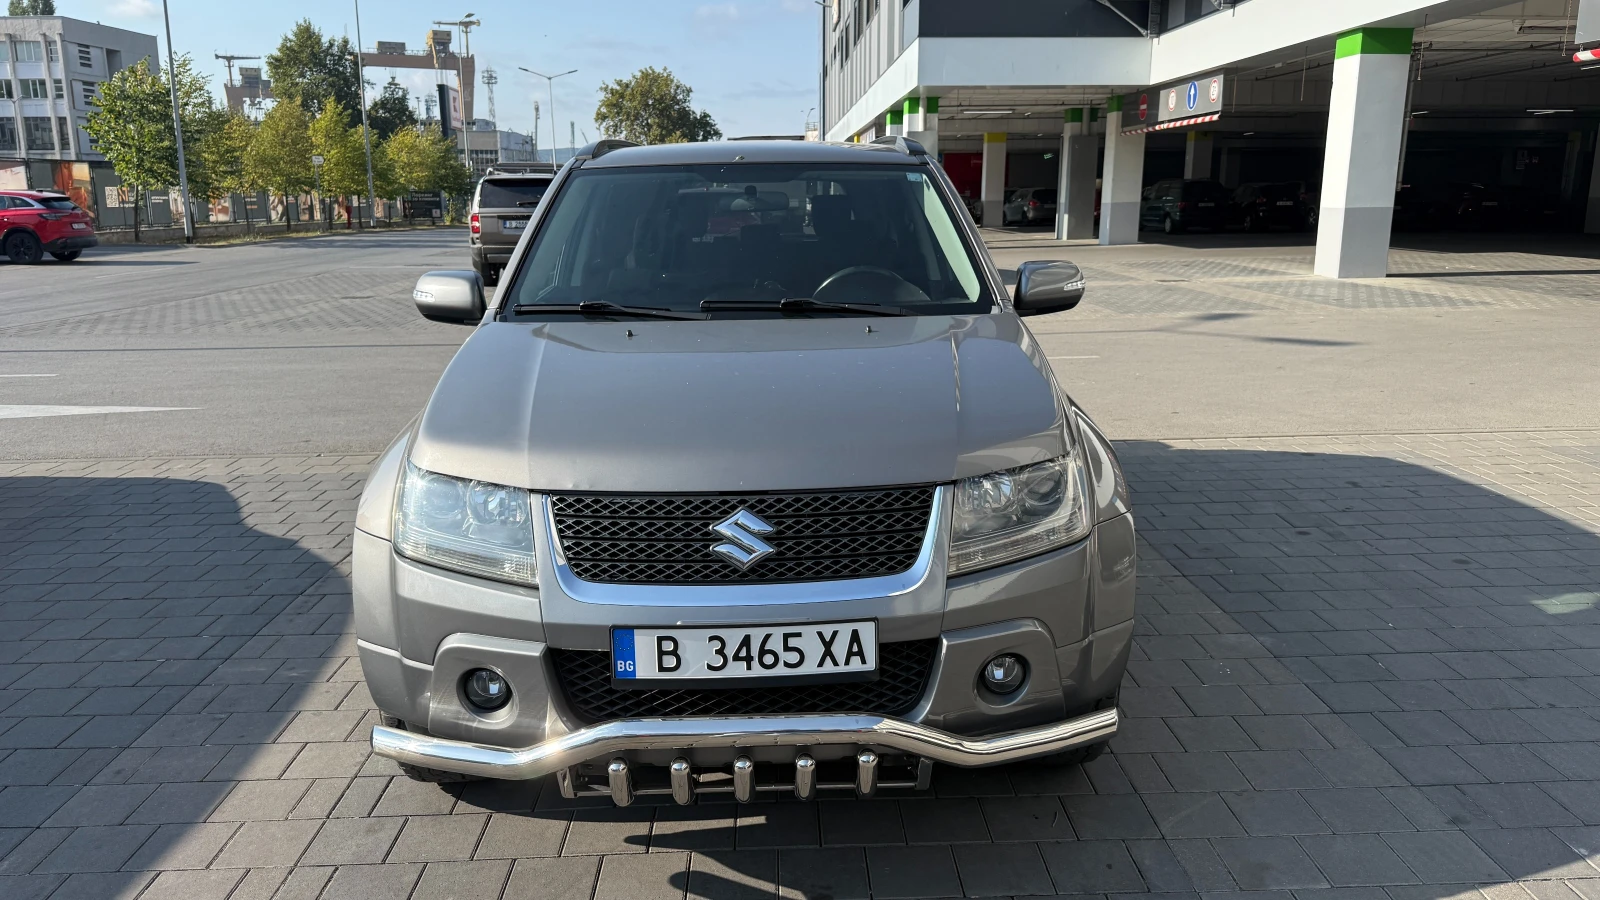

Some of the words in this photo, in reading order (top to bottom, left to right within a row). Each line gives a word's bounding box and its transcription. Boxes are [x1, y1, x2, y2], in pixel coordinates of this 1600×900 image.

[655, 635, 682, 673] B
[705, 631, 805, 672] 3465
[815, 628, 867, 668] XA
[616, 660, 634, 672] BG
